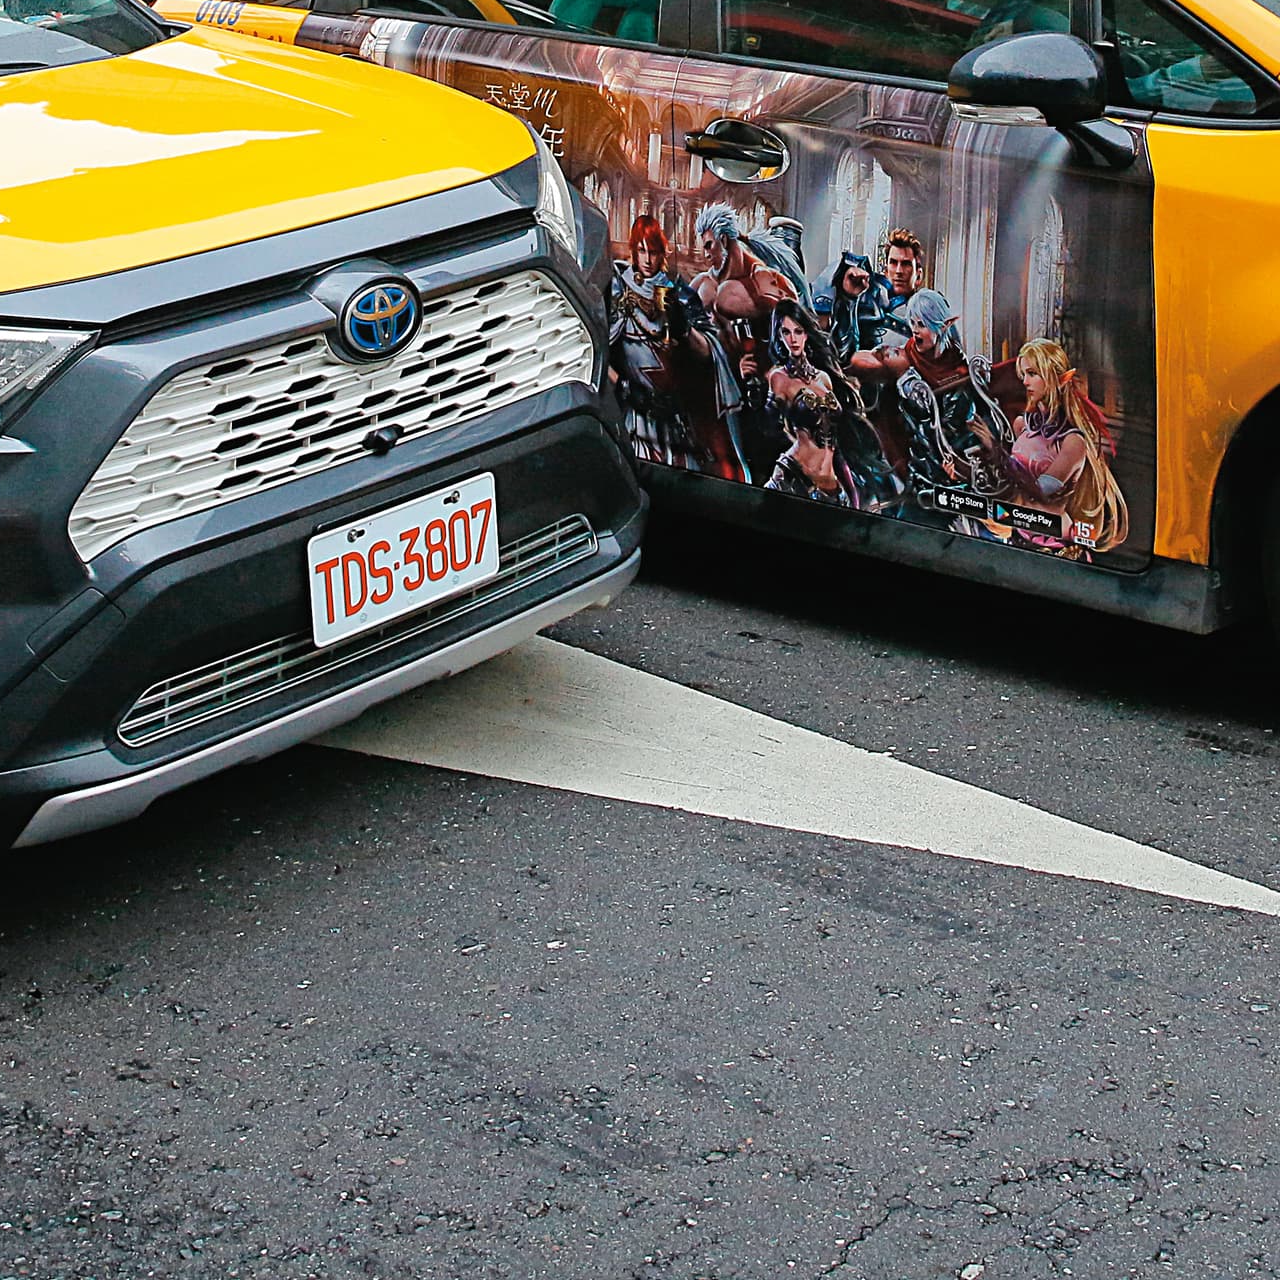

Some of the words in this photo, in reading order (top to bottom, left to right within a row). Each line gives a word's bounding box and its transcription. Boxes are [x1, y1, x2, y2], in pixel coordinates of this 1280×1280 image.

[195, 0, 246, 25] 0103
[950, 493, 965, 505] App
[965, 496, 984, 509] Store
[1012, 508, 1038, 523] Google
[1038, 515, 1053, 528] Play
[315, 499, 492, 624] TDS-3807
